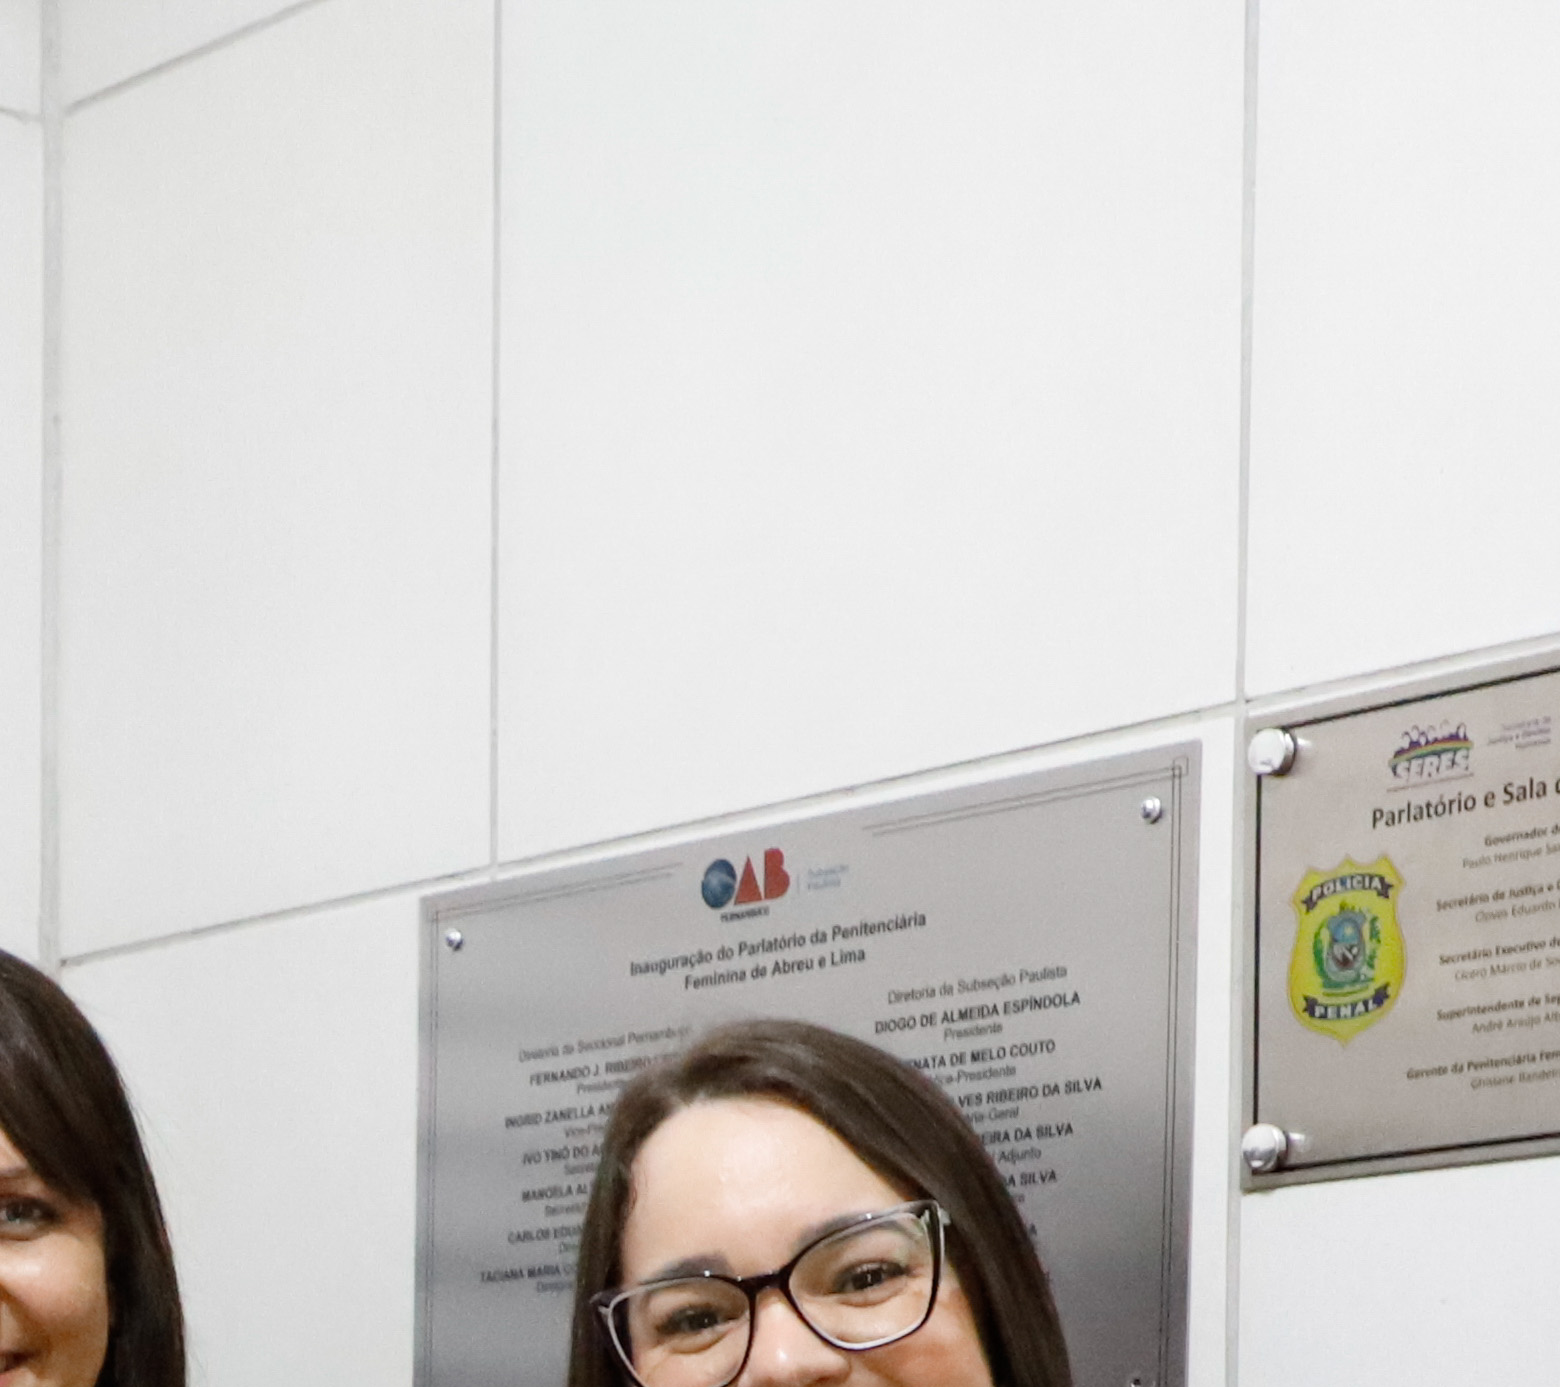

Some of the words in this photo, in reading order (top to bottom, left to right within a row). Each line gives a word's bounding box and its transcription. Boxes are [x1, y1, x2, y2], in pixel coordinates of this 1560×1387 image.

[1372, 790, 1477, 829] Parlatório
[1484, 790, 1495, 808] e
[1503, 777, 1547, 806] Sala
[1484, 827, 1547, 847] Governador
[701, 848, 790, 910] OAB
[630, 951, 712, 978] Inauguração
[717, 945, 734, 960] do
[738, 933, 806, 957] Parlatório
[810, 929, 827, 944] da
[831, 912, 926, 941] Penitenciária
[685, 967, 746, 990] Feminina
[751, 965, 767, 980] de
[771, 958, 814, 977] Abreu
[818, 957, 826, 967] e
[830, 948, 865, 967] Lima
[887, 986, 936, 1005] Diretoria
[940, 983, 954, 997] da
[957, 974, 1016, 995] Subseção
[1019, 966, 1067, 985] Paulista
[874, 1018, 917, 1035] DIOGO
[920, 1015, 937, 1028] DE
[940, 1004, 999, 1025] ALMEIDA
[1314, 999, 1377, 1019] PENAL
[943, 1022, 1003, 1041] Presidente
[950, 1052, 966, 1067] DE
[970, 1045, 1007, 1063] MELO
[1009, 1039, 1056, 1058] COUTO
[529, 1064, 591, 1086] FERNANDO
[987, 1084, 1039, 1105] RIBEIRO
[1042, 1082, 1060, 1097] DA
[1063, 1076, 1102, 1094] SILVA
[1014, 1127, 1032, 1141] DA
[1036, 1122, 1074, 1139] SILVA
[998, 1147, 1042, 1164] Adjunto
[1020, 1168, 1057, 1186] SILVA
